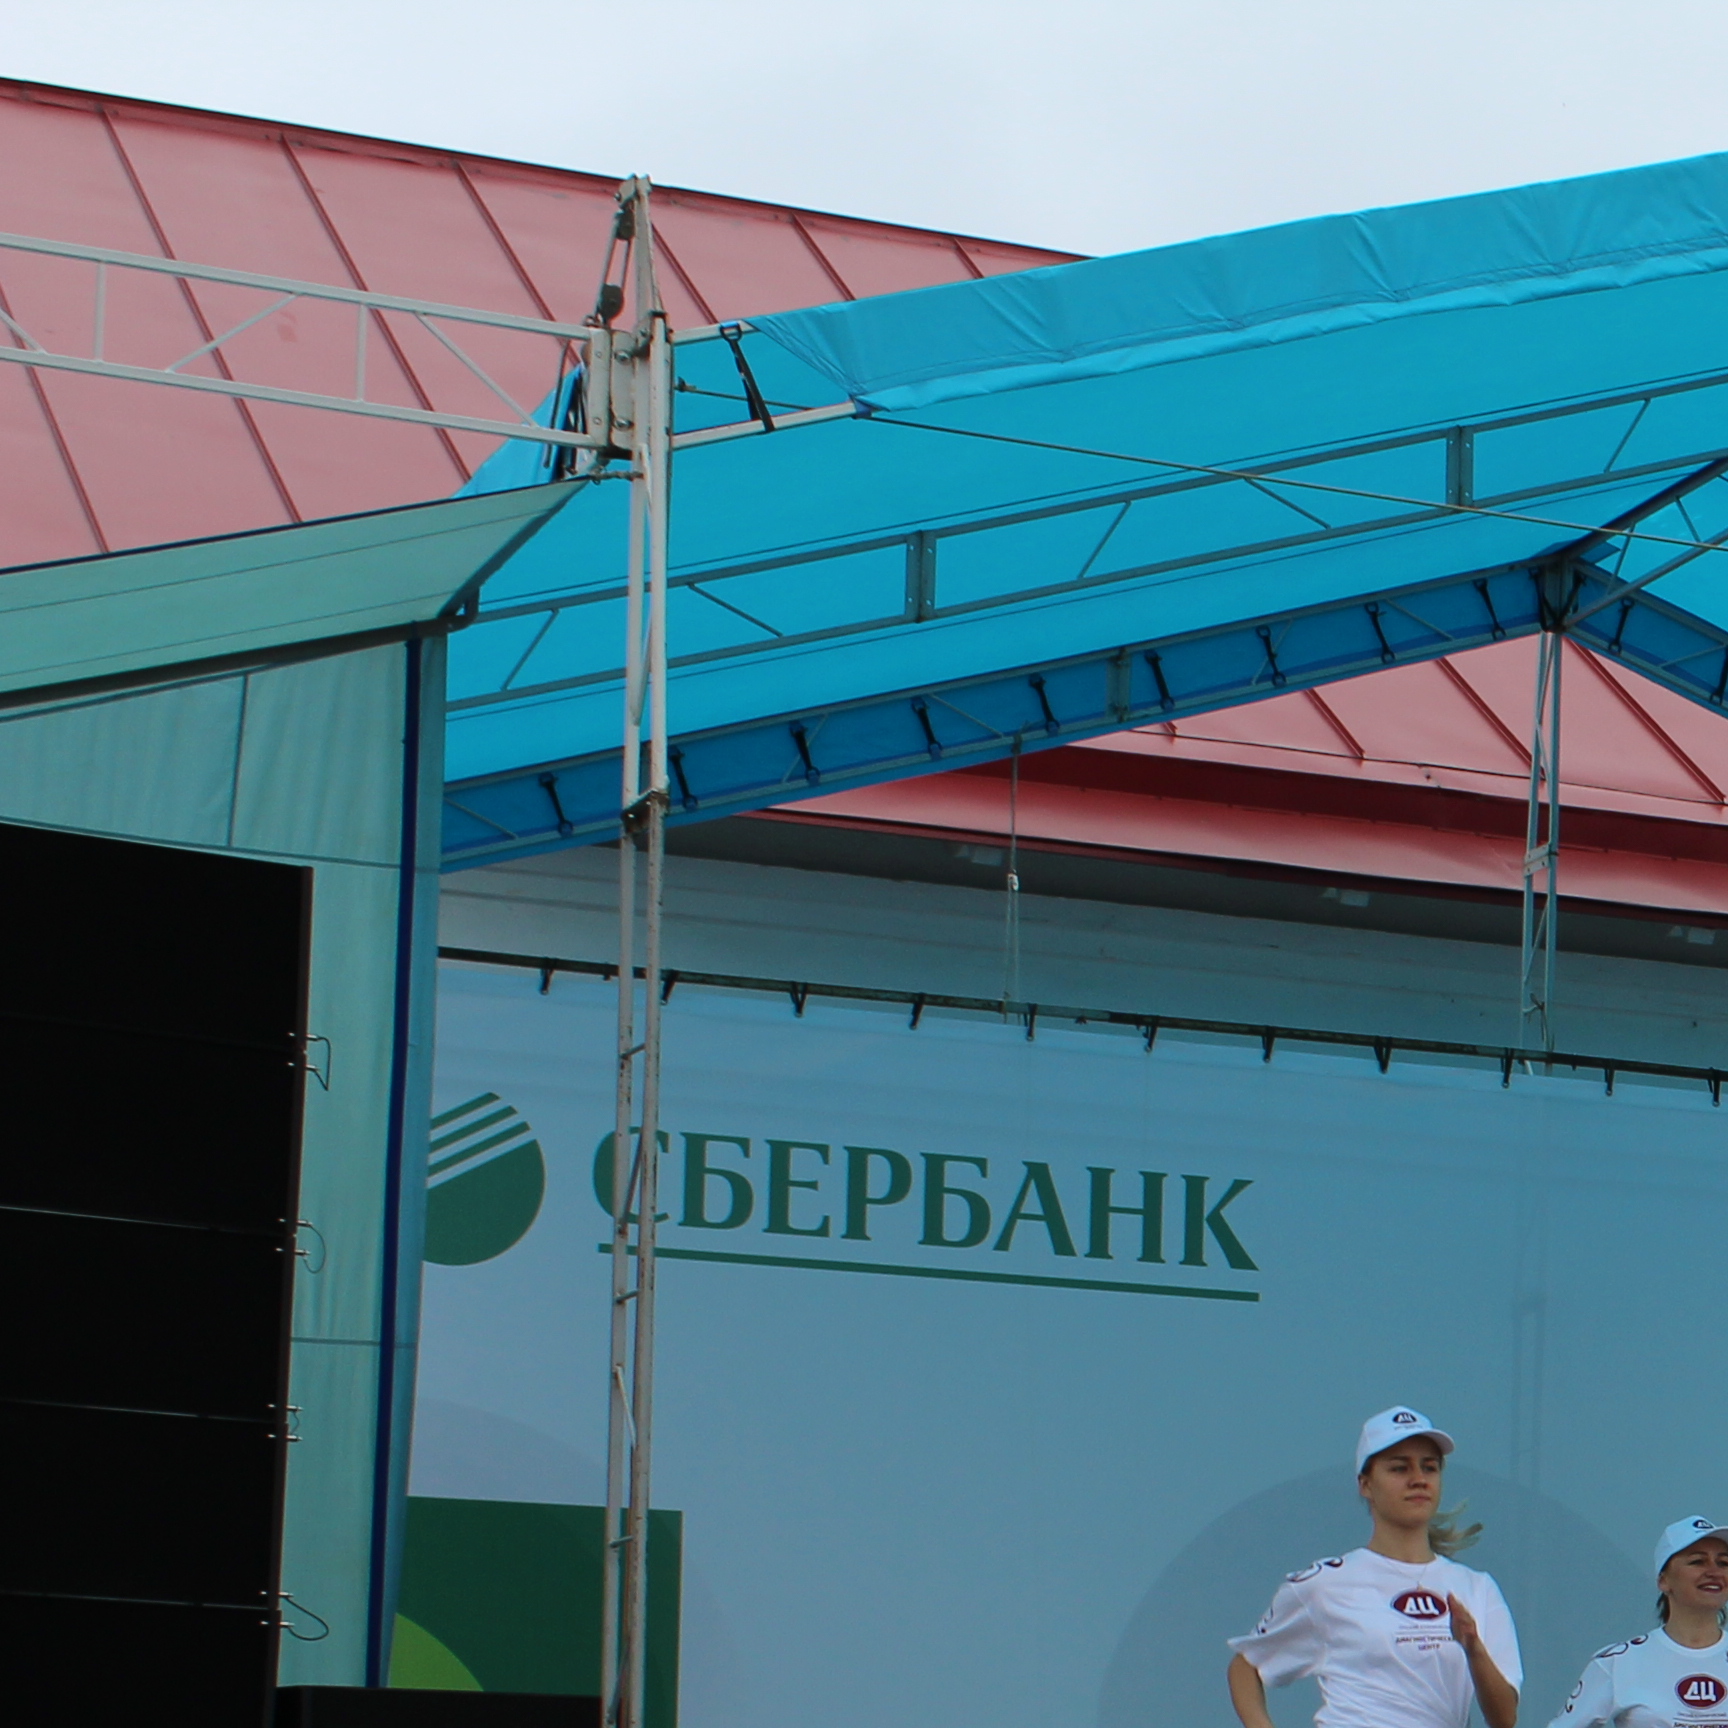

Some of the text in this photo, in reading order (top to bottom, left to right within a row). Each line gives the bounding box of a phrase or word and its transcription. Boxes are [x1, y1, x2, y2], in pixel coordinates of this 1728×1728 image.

[592, 1125, 1260, 1272] СБЕРБАНК
[1403, 1596, 1440, 1616] ДЦ
[1683, 1681, 1717, 1702] ДЦ
